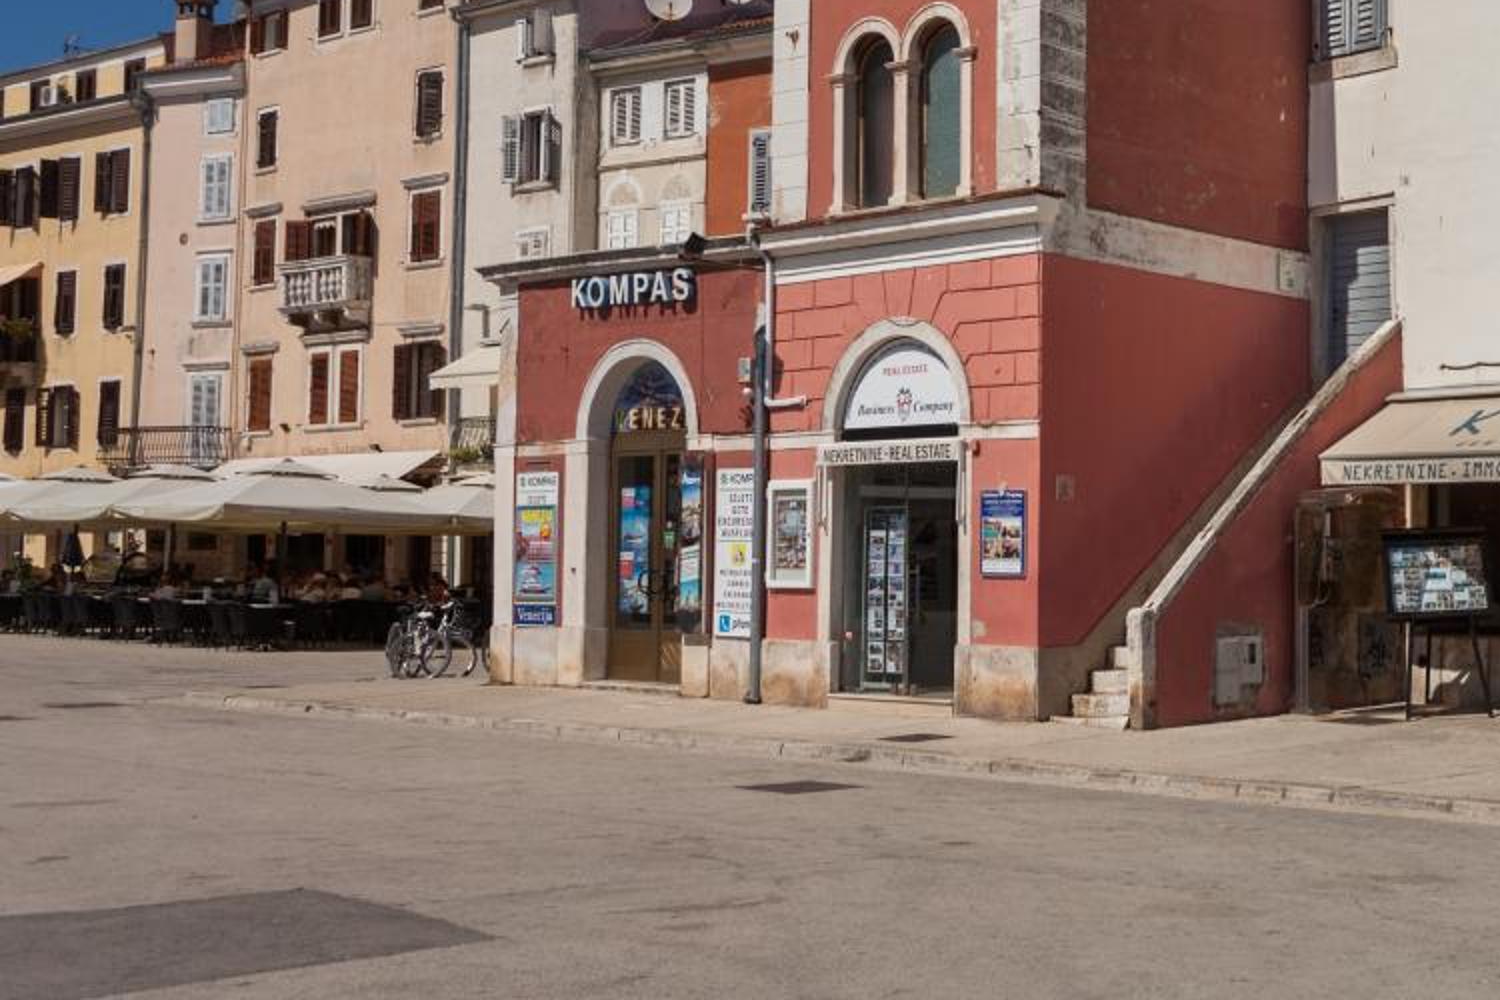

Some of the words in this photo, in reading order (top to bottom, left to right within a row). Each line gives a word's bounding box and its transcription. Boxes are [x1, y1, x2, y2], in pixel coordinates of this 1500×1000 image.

[571, 267, 689, 308] KOMPAS
[823, 447, 882, 463] NEKRETNINE
[890, 447, 914, 460] REAL
[916, 443, 952, 458] ESTATE
